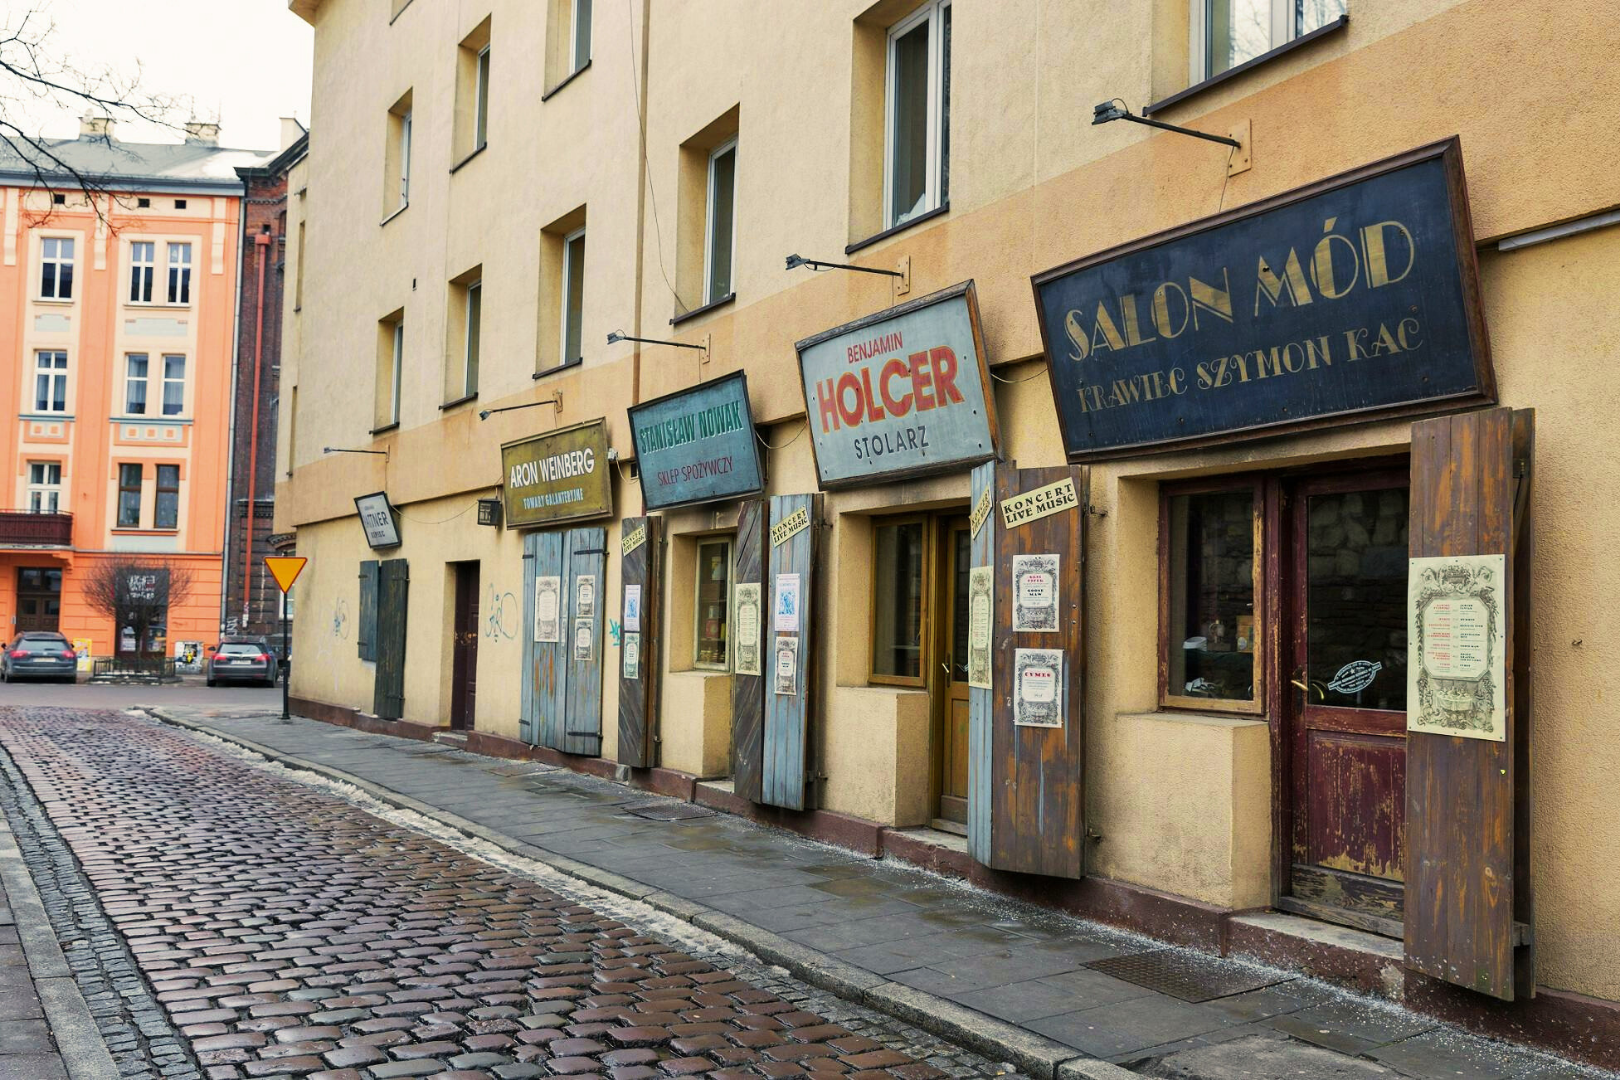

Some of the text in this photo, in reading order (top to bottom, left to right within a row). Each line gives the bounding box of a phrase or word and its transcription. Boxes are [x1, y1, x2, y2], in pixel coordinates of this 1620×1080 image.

[1064, 217, 1416, 362] SALON MÓD
[847, 331, 903, 364] BENJAMIN
[1076, 317, 1424, 414] KRAWIEC SZYMON KAC
[816, 344, 965, 434] HOLCER
[639, 400, 744, 456] STANISŁAW NOWAK
[853, 425, 930, 460] STOLARZ
[509, 447, 595, 489] ARON WEINBERG
[657, 456, 734, 487] SKLEP SPOŻYWCZY
[1003, 482, 1074, 515] KONCERT
[1005, 492, 1076, 525] LIVE MUSIC
[772, 509, 806, 537] KONCERT
[773, 517, 808, 543] LIVE MUSIC
